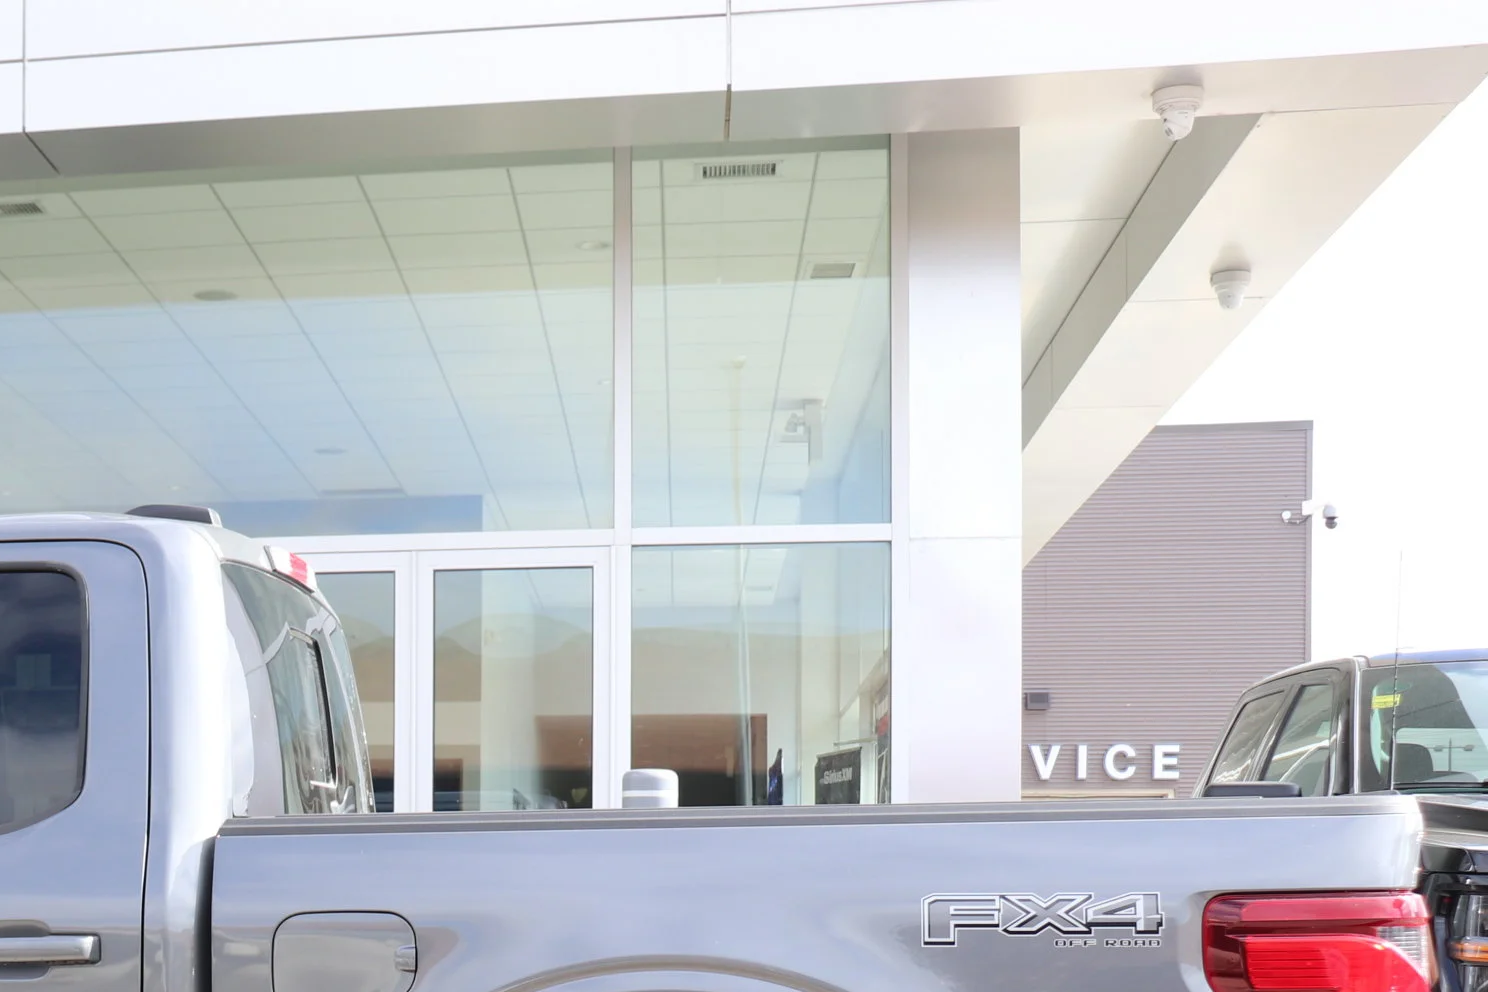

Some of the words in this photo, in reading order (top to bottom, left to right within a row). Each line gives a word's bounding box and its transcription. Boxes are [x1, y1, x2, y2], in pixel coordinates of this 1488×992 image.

[921, 892, 1165, 947] FX4
[1054, 938, 1097, 948] OFF
[1104, 938, 1162, 948] ROAD
